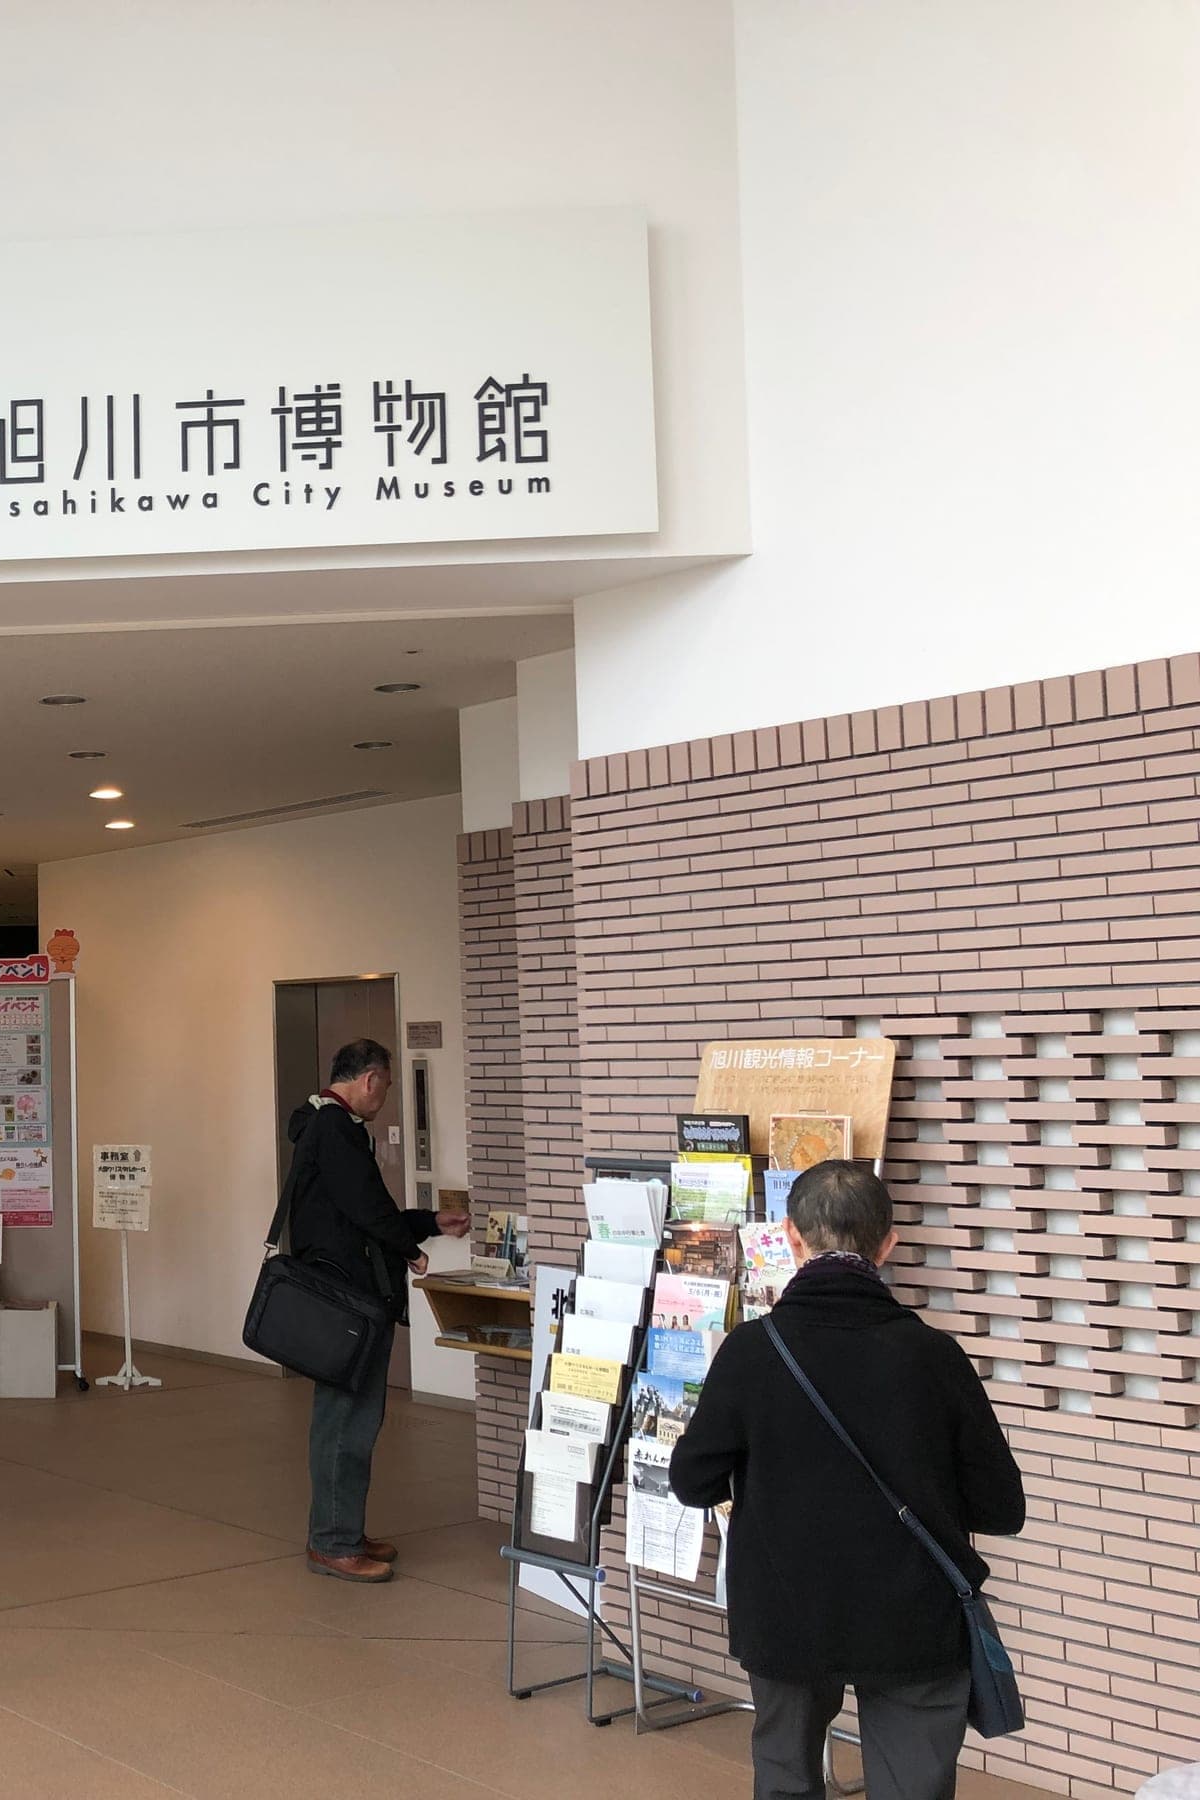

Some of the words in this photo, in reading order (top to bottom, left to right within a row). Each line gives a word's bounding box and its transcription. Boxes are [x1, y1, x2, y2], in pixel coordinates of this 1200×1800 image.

[253, 481, 342, 510] City
[375, 473, 551, 500] Museum
[711, 1046, 885, 1070] 旭川観光情報コーナー
